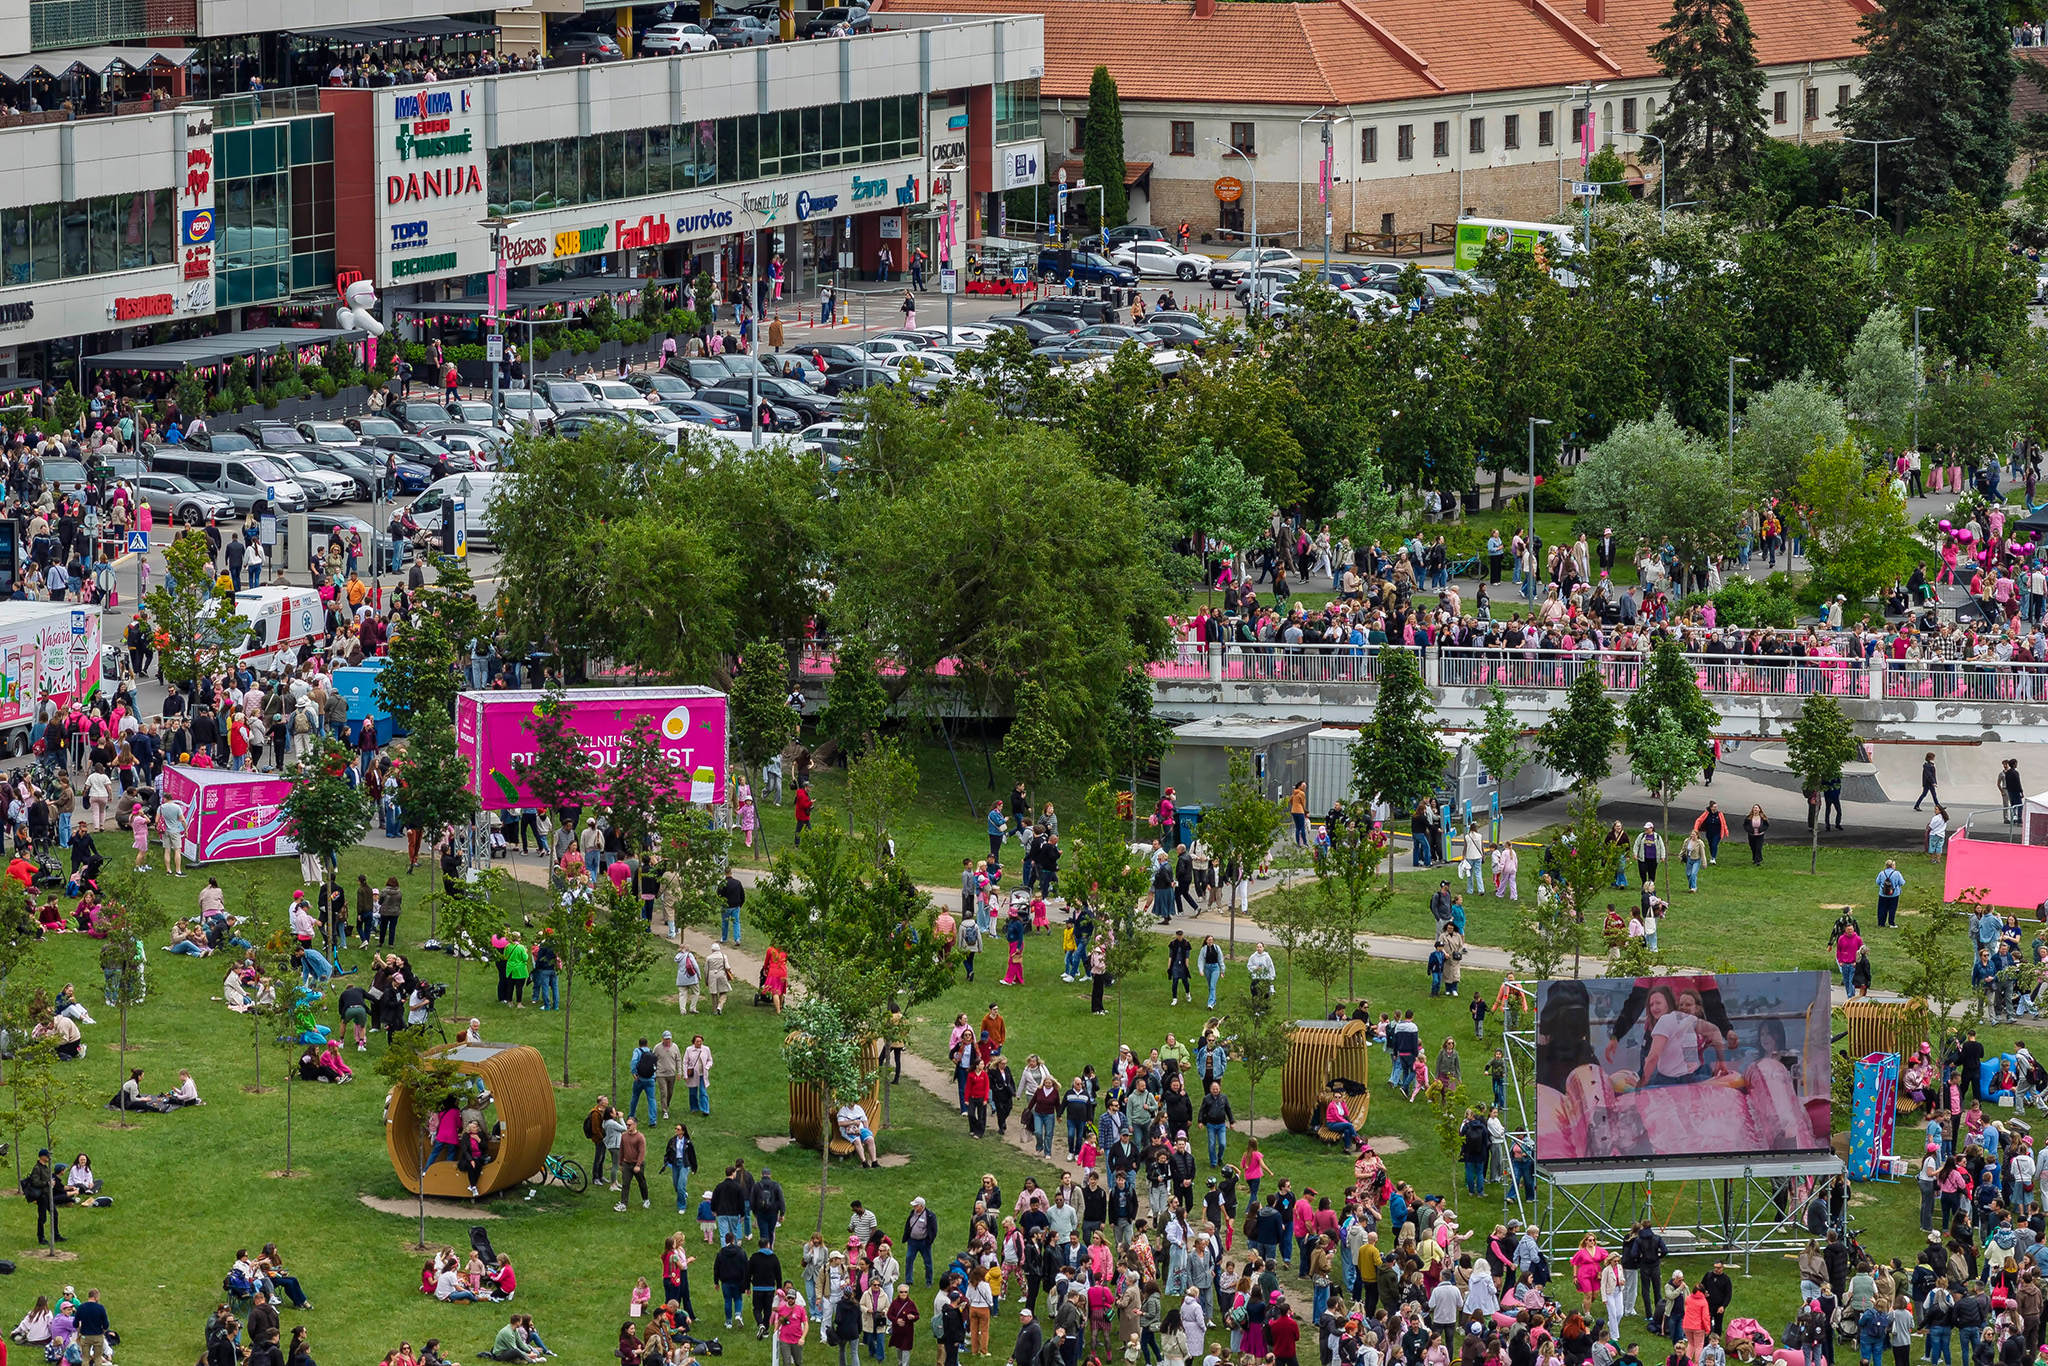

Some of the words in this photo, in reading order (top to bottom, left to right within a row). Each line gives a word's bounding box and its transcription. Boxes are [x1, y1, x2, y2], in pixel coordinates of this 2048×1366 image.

[395, 90, 453, 120] MAXIMA
[414, 118, 450, 135] EURO
[932, 141, 966, 162] CASCADA
[387, 164, 483, 205] DANIJA
[192, 220, 210, 232] PEPCO
[391, 220, 429, 241] TOPO
[615, 213, 670, 250] FanClub
[676, 208, 733, 234] eurokos
[500, 235, 546, 266] Pegasas
[553, 223, 609, 258] SUBWAY
[392, 252, 457, 278] DEICHMANN
[115, 293, 174, 321] HESBURGER
[40, 626, 71, 652] Vasara
[49, 648, 64, 656] VISUS
[48, 657, 66, 666] METUS
